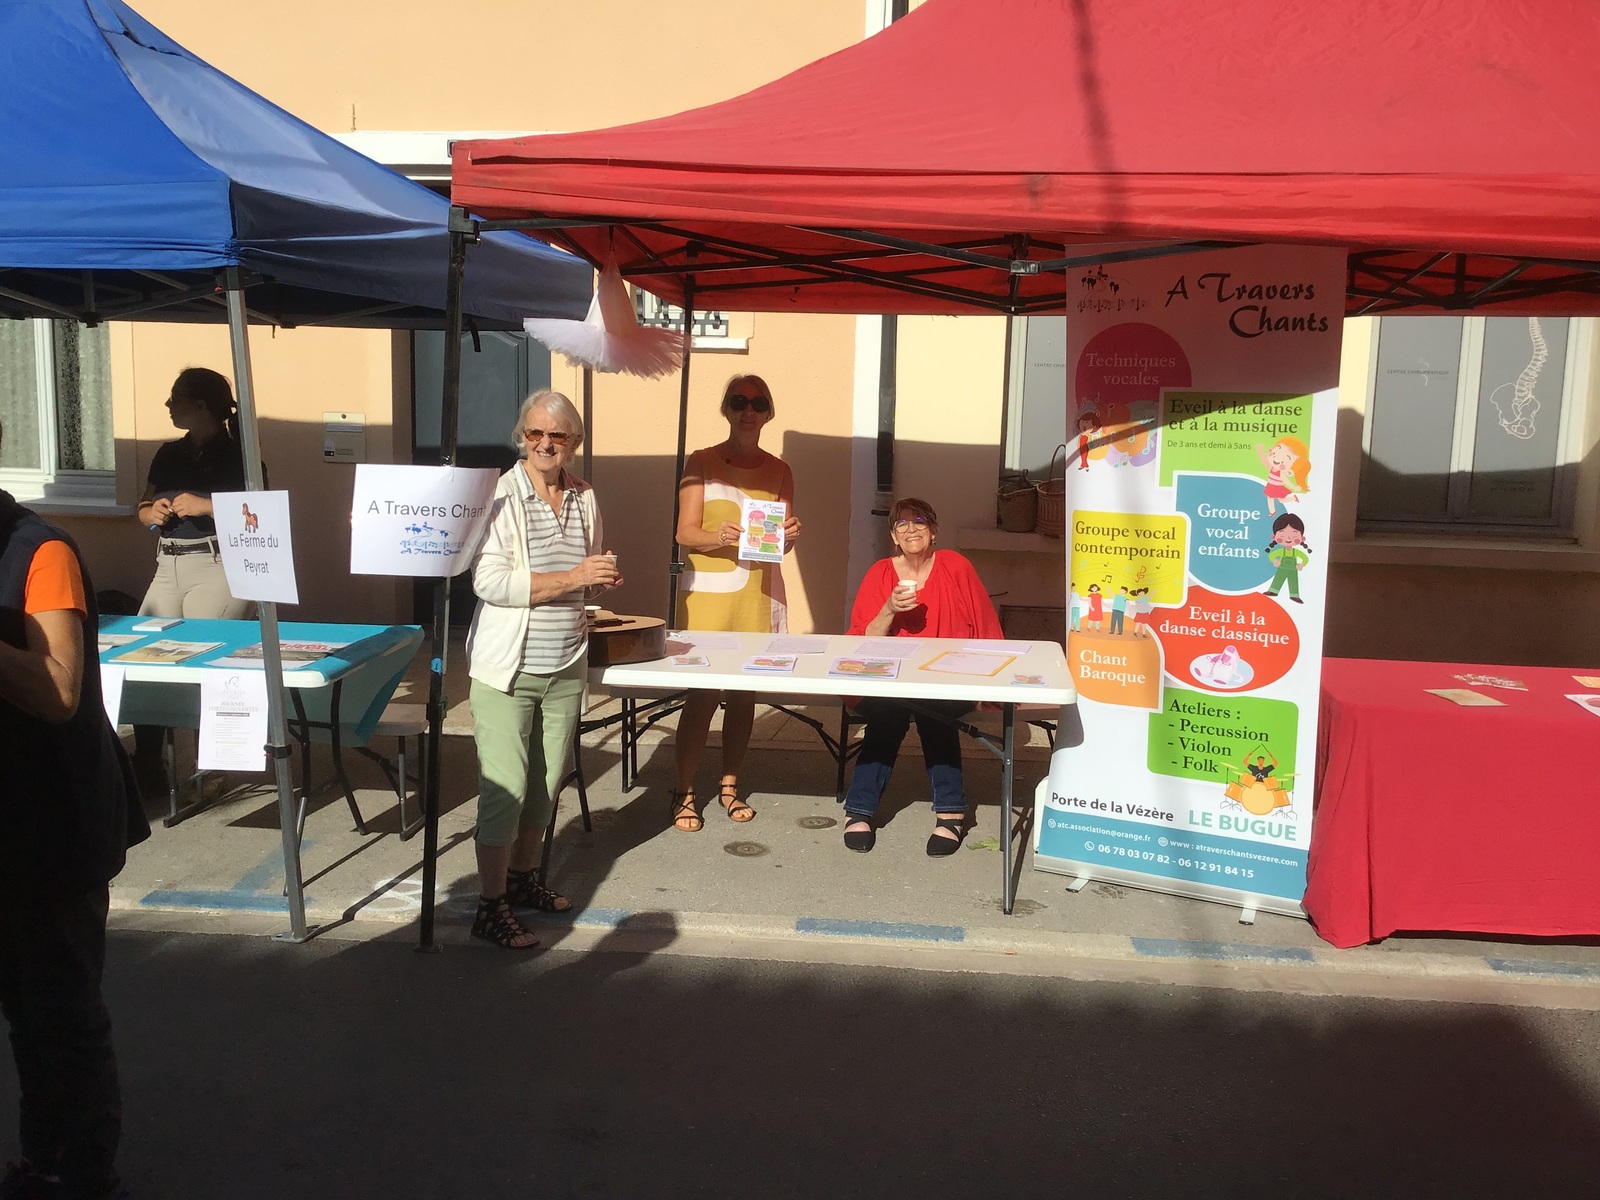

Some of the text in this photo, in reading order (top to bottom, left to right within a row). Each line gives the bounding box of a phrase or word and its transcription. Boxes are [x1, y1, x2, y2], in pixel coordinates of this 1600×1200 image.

[1164, 272, 1315, 307] A Travers
[1229, 305, 1329, 338] Chants
[1086, 353, 1176, 371] Techniques
[1103, 372, 1160, 385] vocales
[1169, 399, 1303, 417] Eveil à la danse
[1168, 417, 1298, 438] et à la musique
[1167, 440, 1178, 448] De
[1179, 440, 1184, 448] 3
[1208, 440, 1227, 449] demi
[1228, 441, 1233, 449] à
[367, 500, 380, 514] A
[384, 500, 447, 518] Travers
[1197, 503, 1261, 527] Groupe
[228, 533, 279, 548] La Ferme du
[1075, 520, 1176, 541] Groupe vocal
[1205, 524, 1249, 540] vocal
[1074, 542, 1181, 561] contemporain
[1198, 542, 1260, 559] enfants
[243, 558, 270, 576] Peyrat
[1188, 605, 1266, 626] Eveil à la
[1159, 620, 1290, 648] danse classique
[1079, 649, 1128, 667] Chant
[1079, 666, 1146, 686] Baroque
[1169, 699, 1231, 719] Ateliers
[1179, 718, 1270, 742] Percussion
[1178, 737, 1232, 757] Violon
[1182, 756, 1219, 774] Folk
[1051, 792, 1174, 822] Porte de la Vézère
[1057, 820, 1152, 842] atc.association@orange.fr
[1188, 809, 1297, 842] LE BUGUE
[1098, 844, 1111, 854] 06
[1112, 846, 1126, 856] 78
[1127, 849, 1140, 859] 03
[1142, 852, 1155, 861] 07
[1157, 854, 1170, 864] 82
[1178, 858, 1192, 868] 06
[1194, 860, 1207, 870] 12
[1208, 863, 1222, 873] 91
[1224, 865, 1239, 876] 84
[1241, 868, 1254, 879] 15
[1169, 839, 1190, 849] www
[1195, 844, 1298, 867] atraverschantsvezere.com
